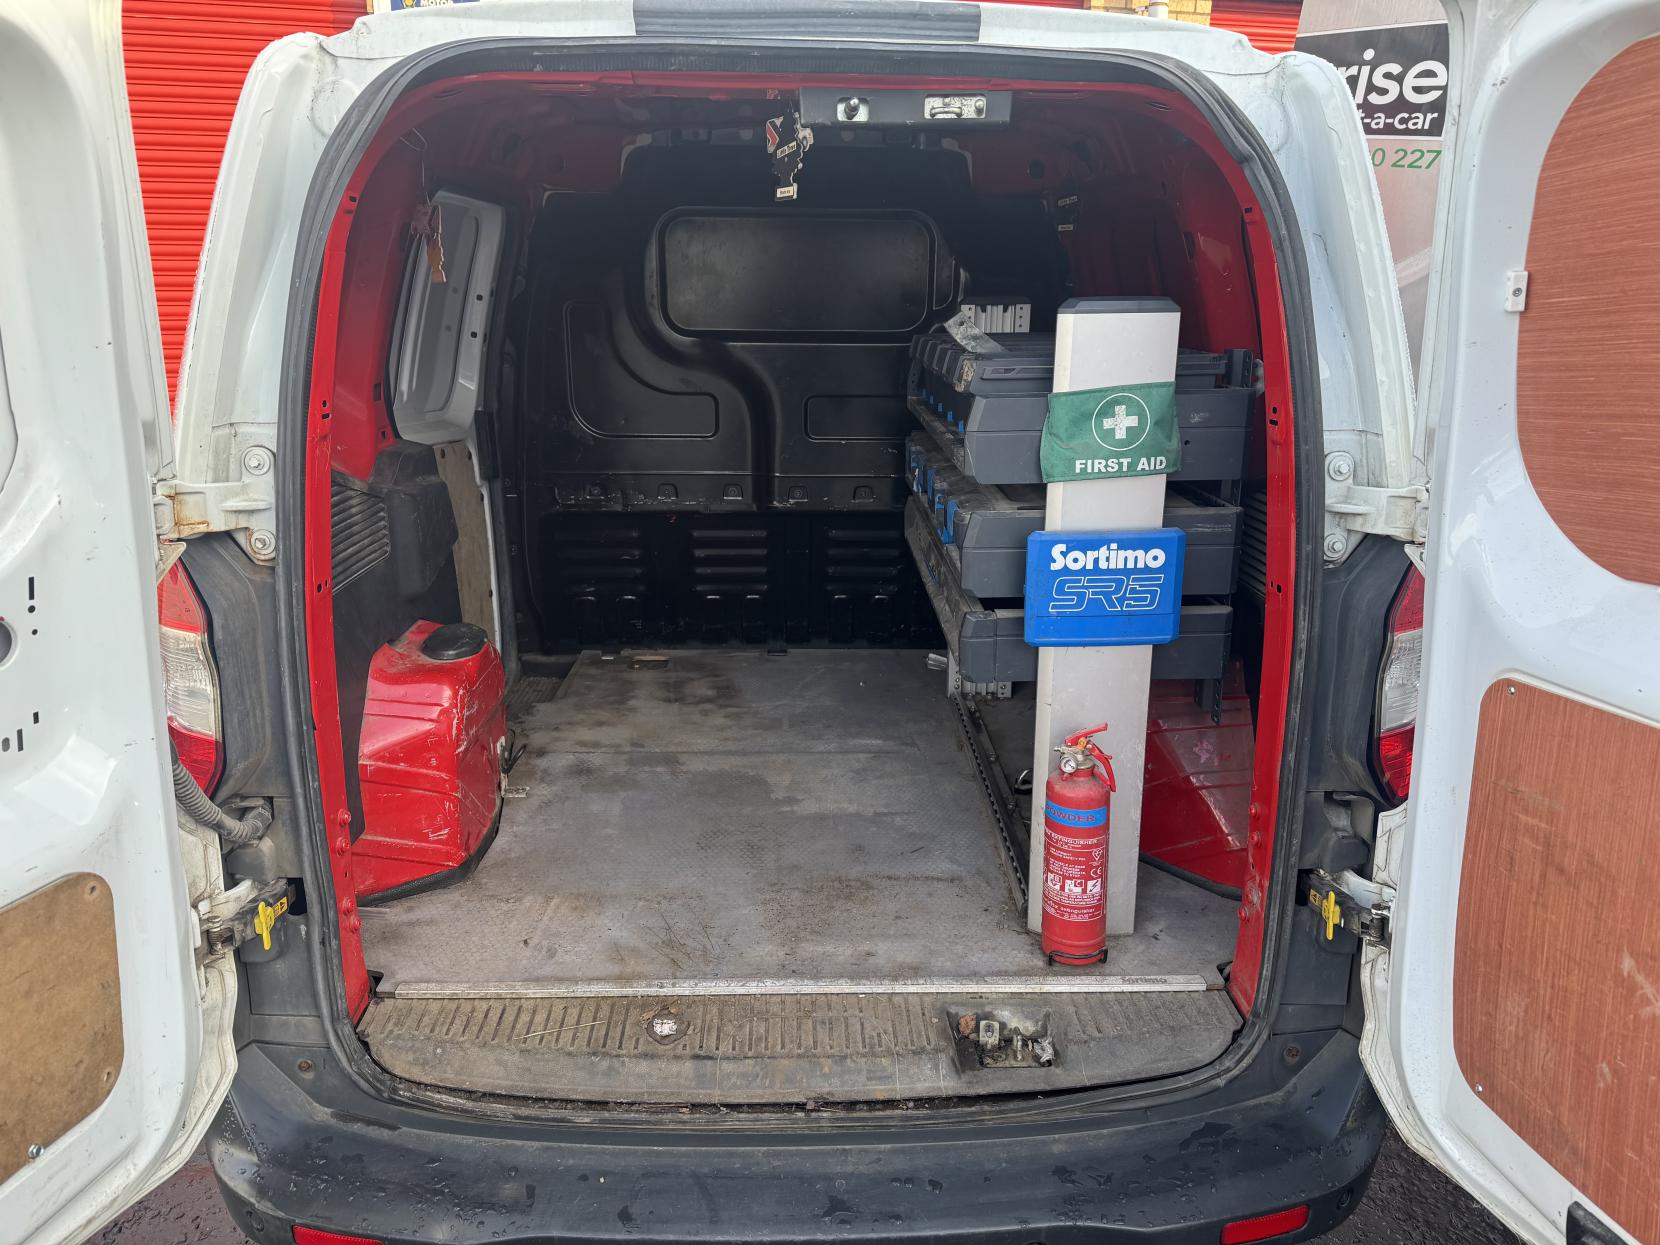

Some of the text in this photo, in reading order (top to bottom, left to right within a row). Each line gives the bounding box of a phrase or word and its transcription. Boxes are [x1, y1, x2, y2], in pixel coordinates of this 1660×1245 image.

[1391, 147, 1442, 170] 227
[1075, 456, 1167, 473] FIRST AID
[1050, 543, 1166, 571] Sortimo
[1049, 574, 1165, 612] SR5
